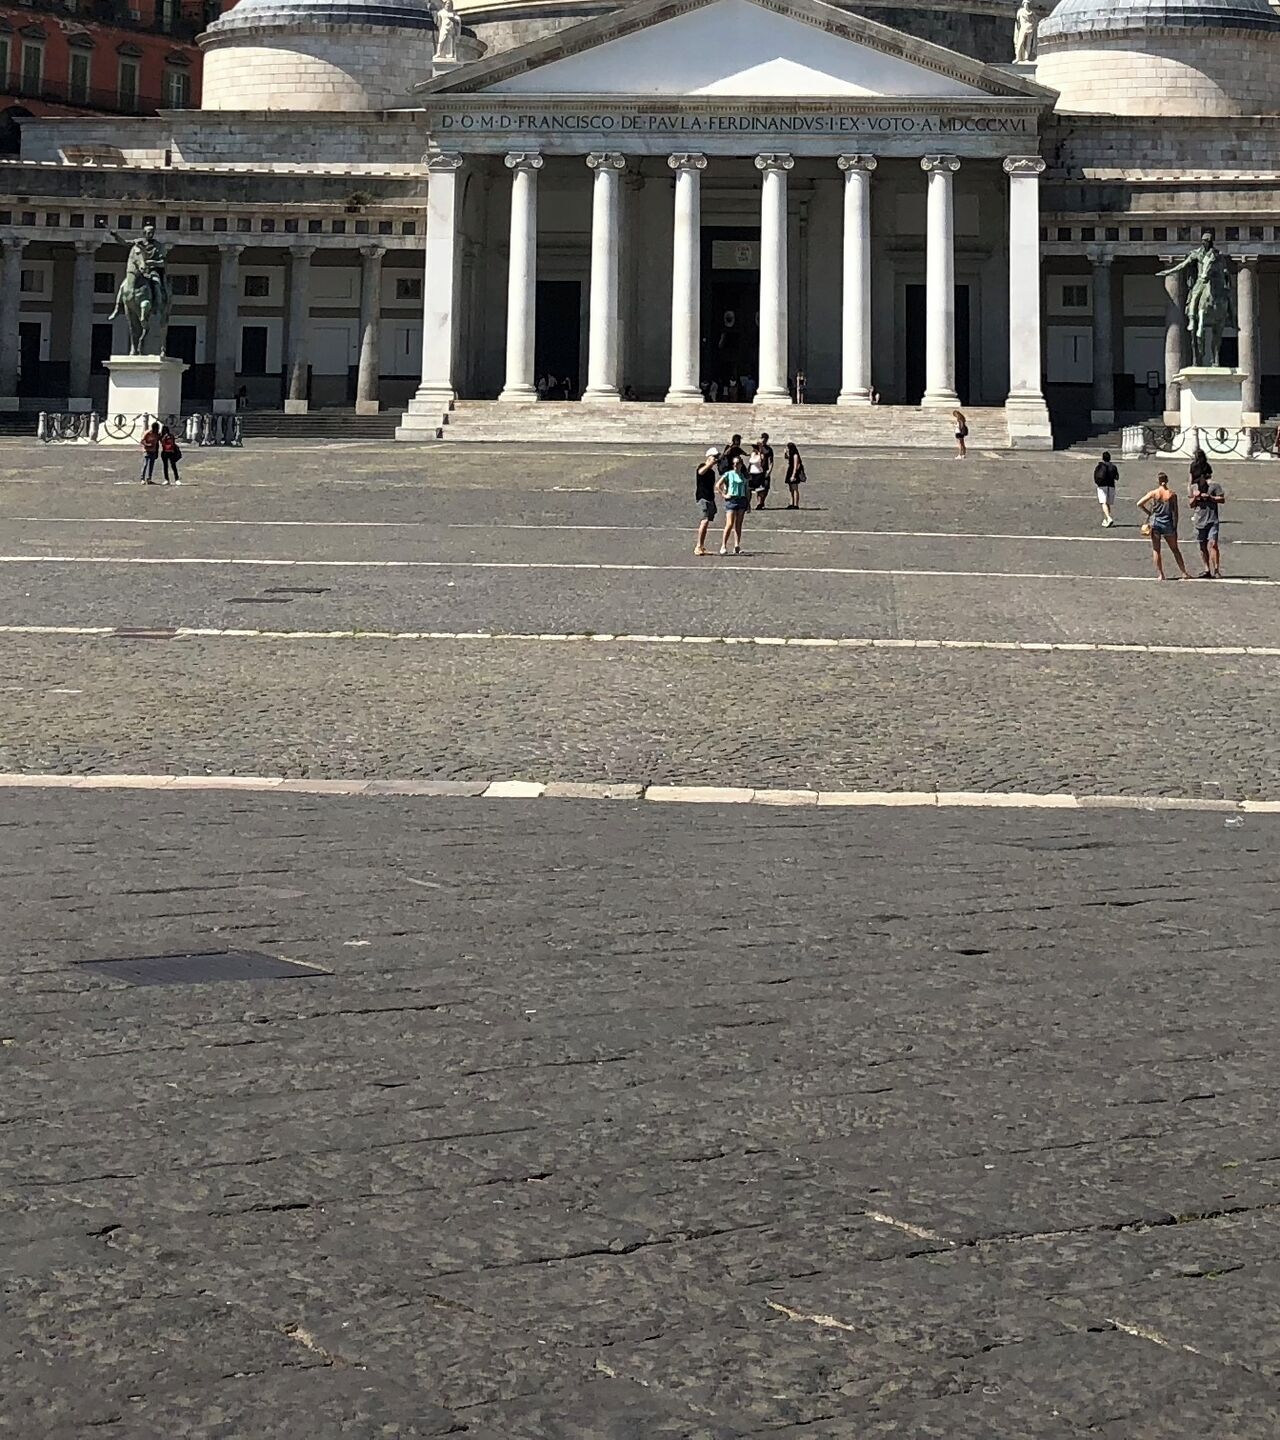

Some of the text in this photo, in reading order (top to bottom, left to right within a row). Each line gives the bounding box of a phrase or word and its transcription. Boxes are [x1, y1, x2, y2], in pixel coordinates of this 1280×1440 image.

[518, 115, 614, 130] FRANCISCO
[621, 116, 642, 130] DE
[649, 116, 702, 130] PAVLA
[709, 116, 824, 131] FERDINANDVS
[839, 117, 860, 131] EX
[867, 117, 915, 131] VOTO
[939, 117, 1026, 132] MDCCCXVI
